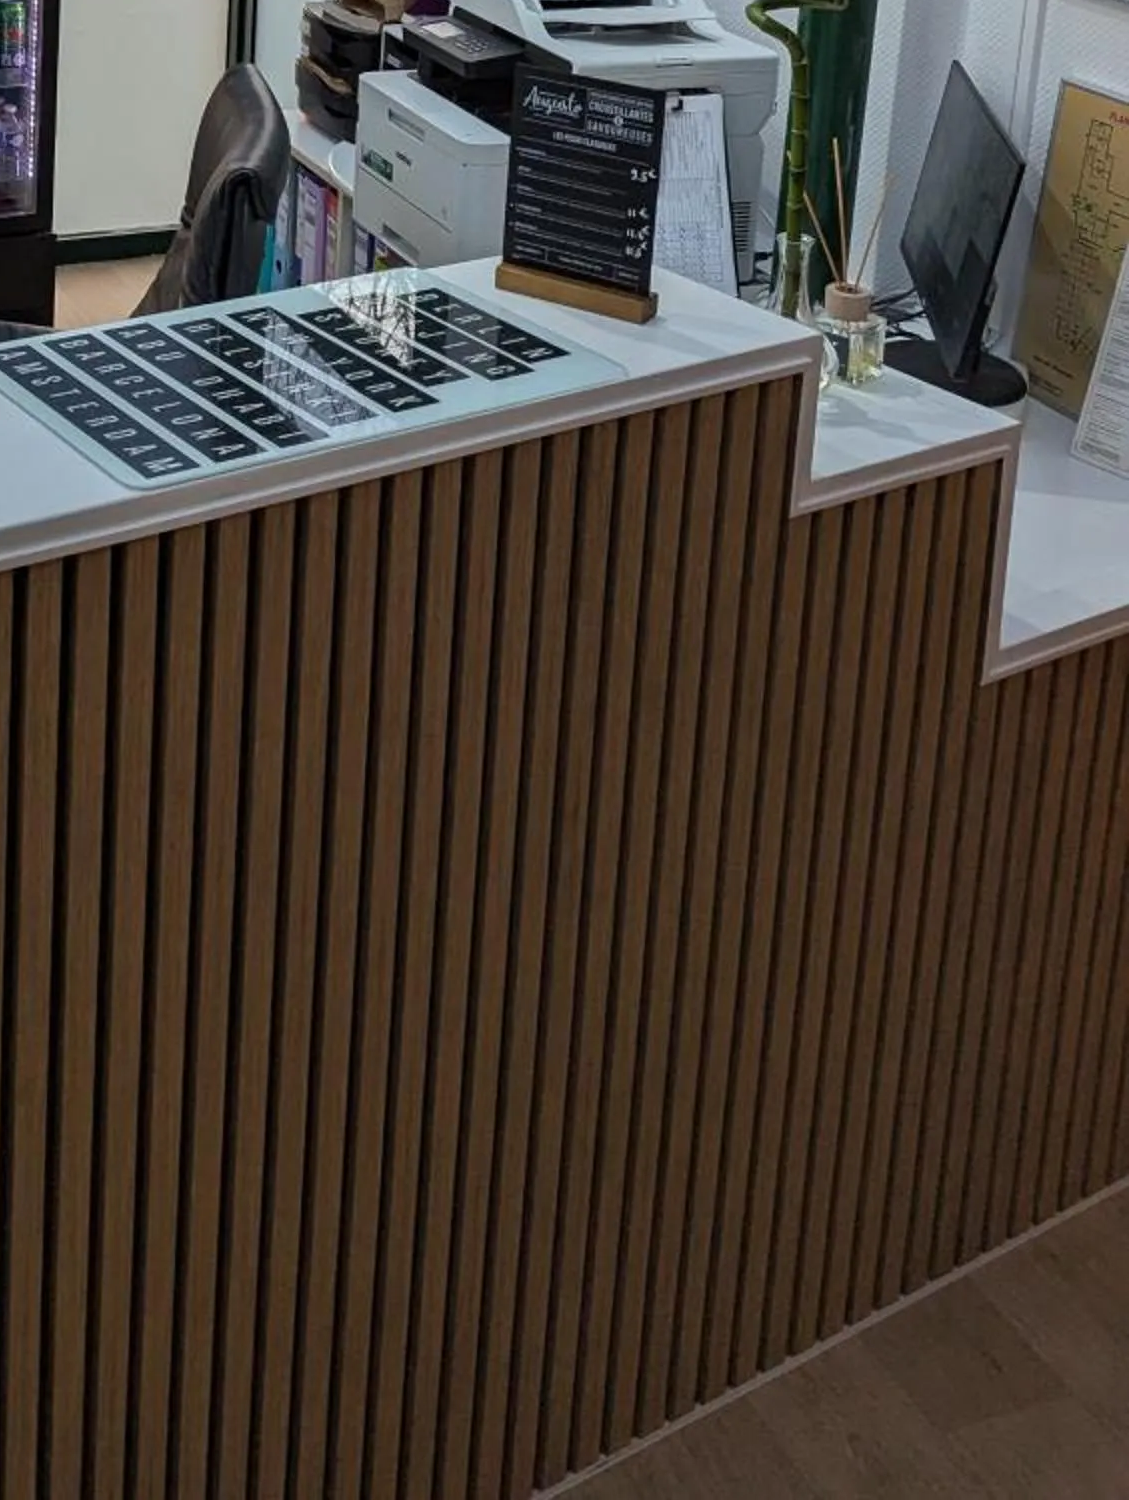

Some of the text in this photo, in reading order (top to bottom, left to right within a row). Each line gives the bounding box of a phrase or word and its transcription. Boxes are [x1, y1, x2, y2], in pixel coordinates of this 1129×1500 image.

[58, 338, 247, 456] BARCELONA
[118, 328, 303, 440] ABU DHABI
[328, 356, 421, 409] YORK
